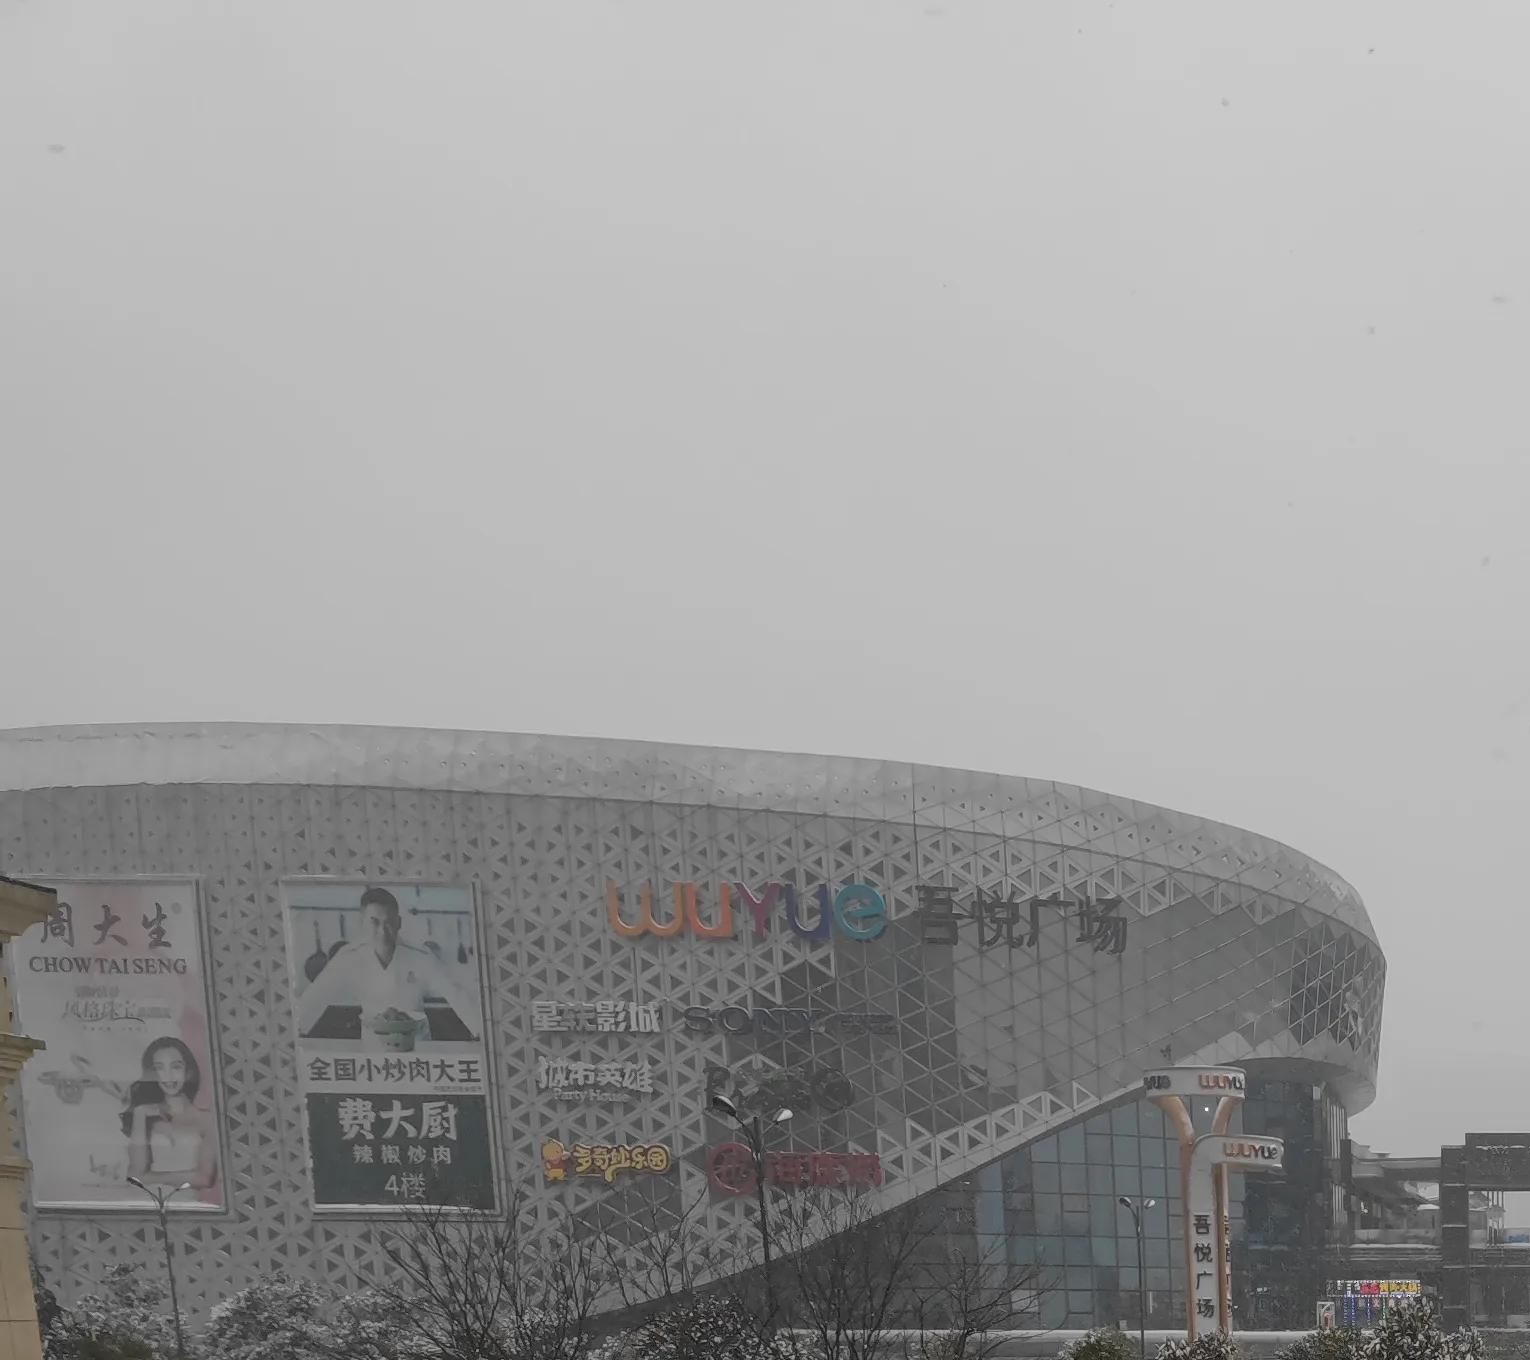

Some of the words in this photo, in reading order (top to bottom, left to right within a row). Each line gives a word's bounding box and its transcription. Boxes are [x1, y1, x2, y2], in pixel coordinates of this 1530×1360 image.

[40, 902, 172, 949] 周大生
[916, 885, 1128, 955] 吾悦广场
[29, 956, 92, 974] CHOW
[94, 957, 130, 975] TAI
[133, 957, 188, 976] SENG
[306, 1056, 482, 1083] 全国小炒肉大王
[538, 1056, 654, 1093] 城市英雄
[337, 1097, 459, 1140] 费大厨
[352, 1144, 453, 1164] 辣椒炒肉
[384, 1172, 428, 1199] 4楼
[1192, 1214, 1215, 1318] 吾悦广场
